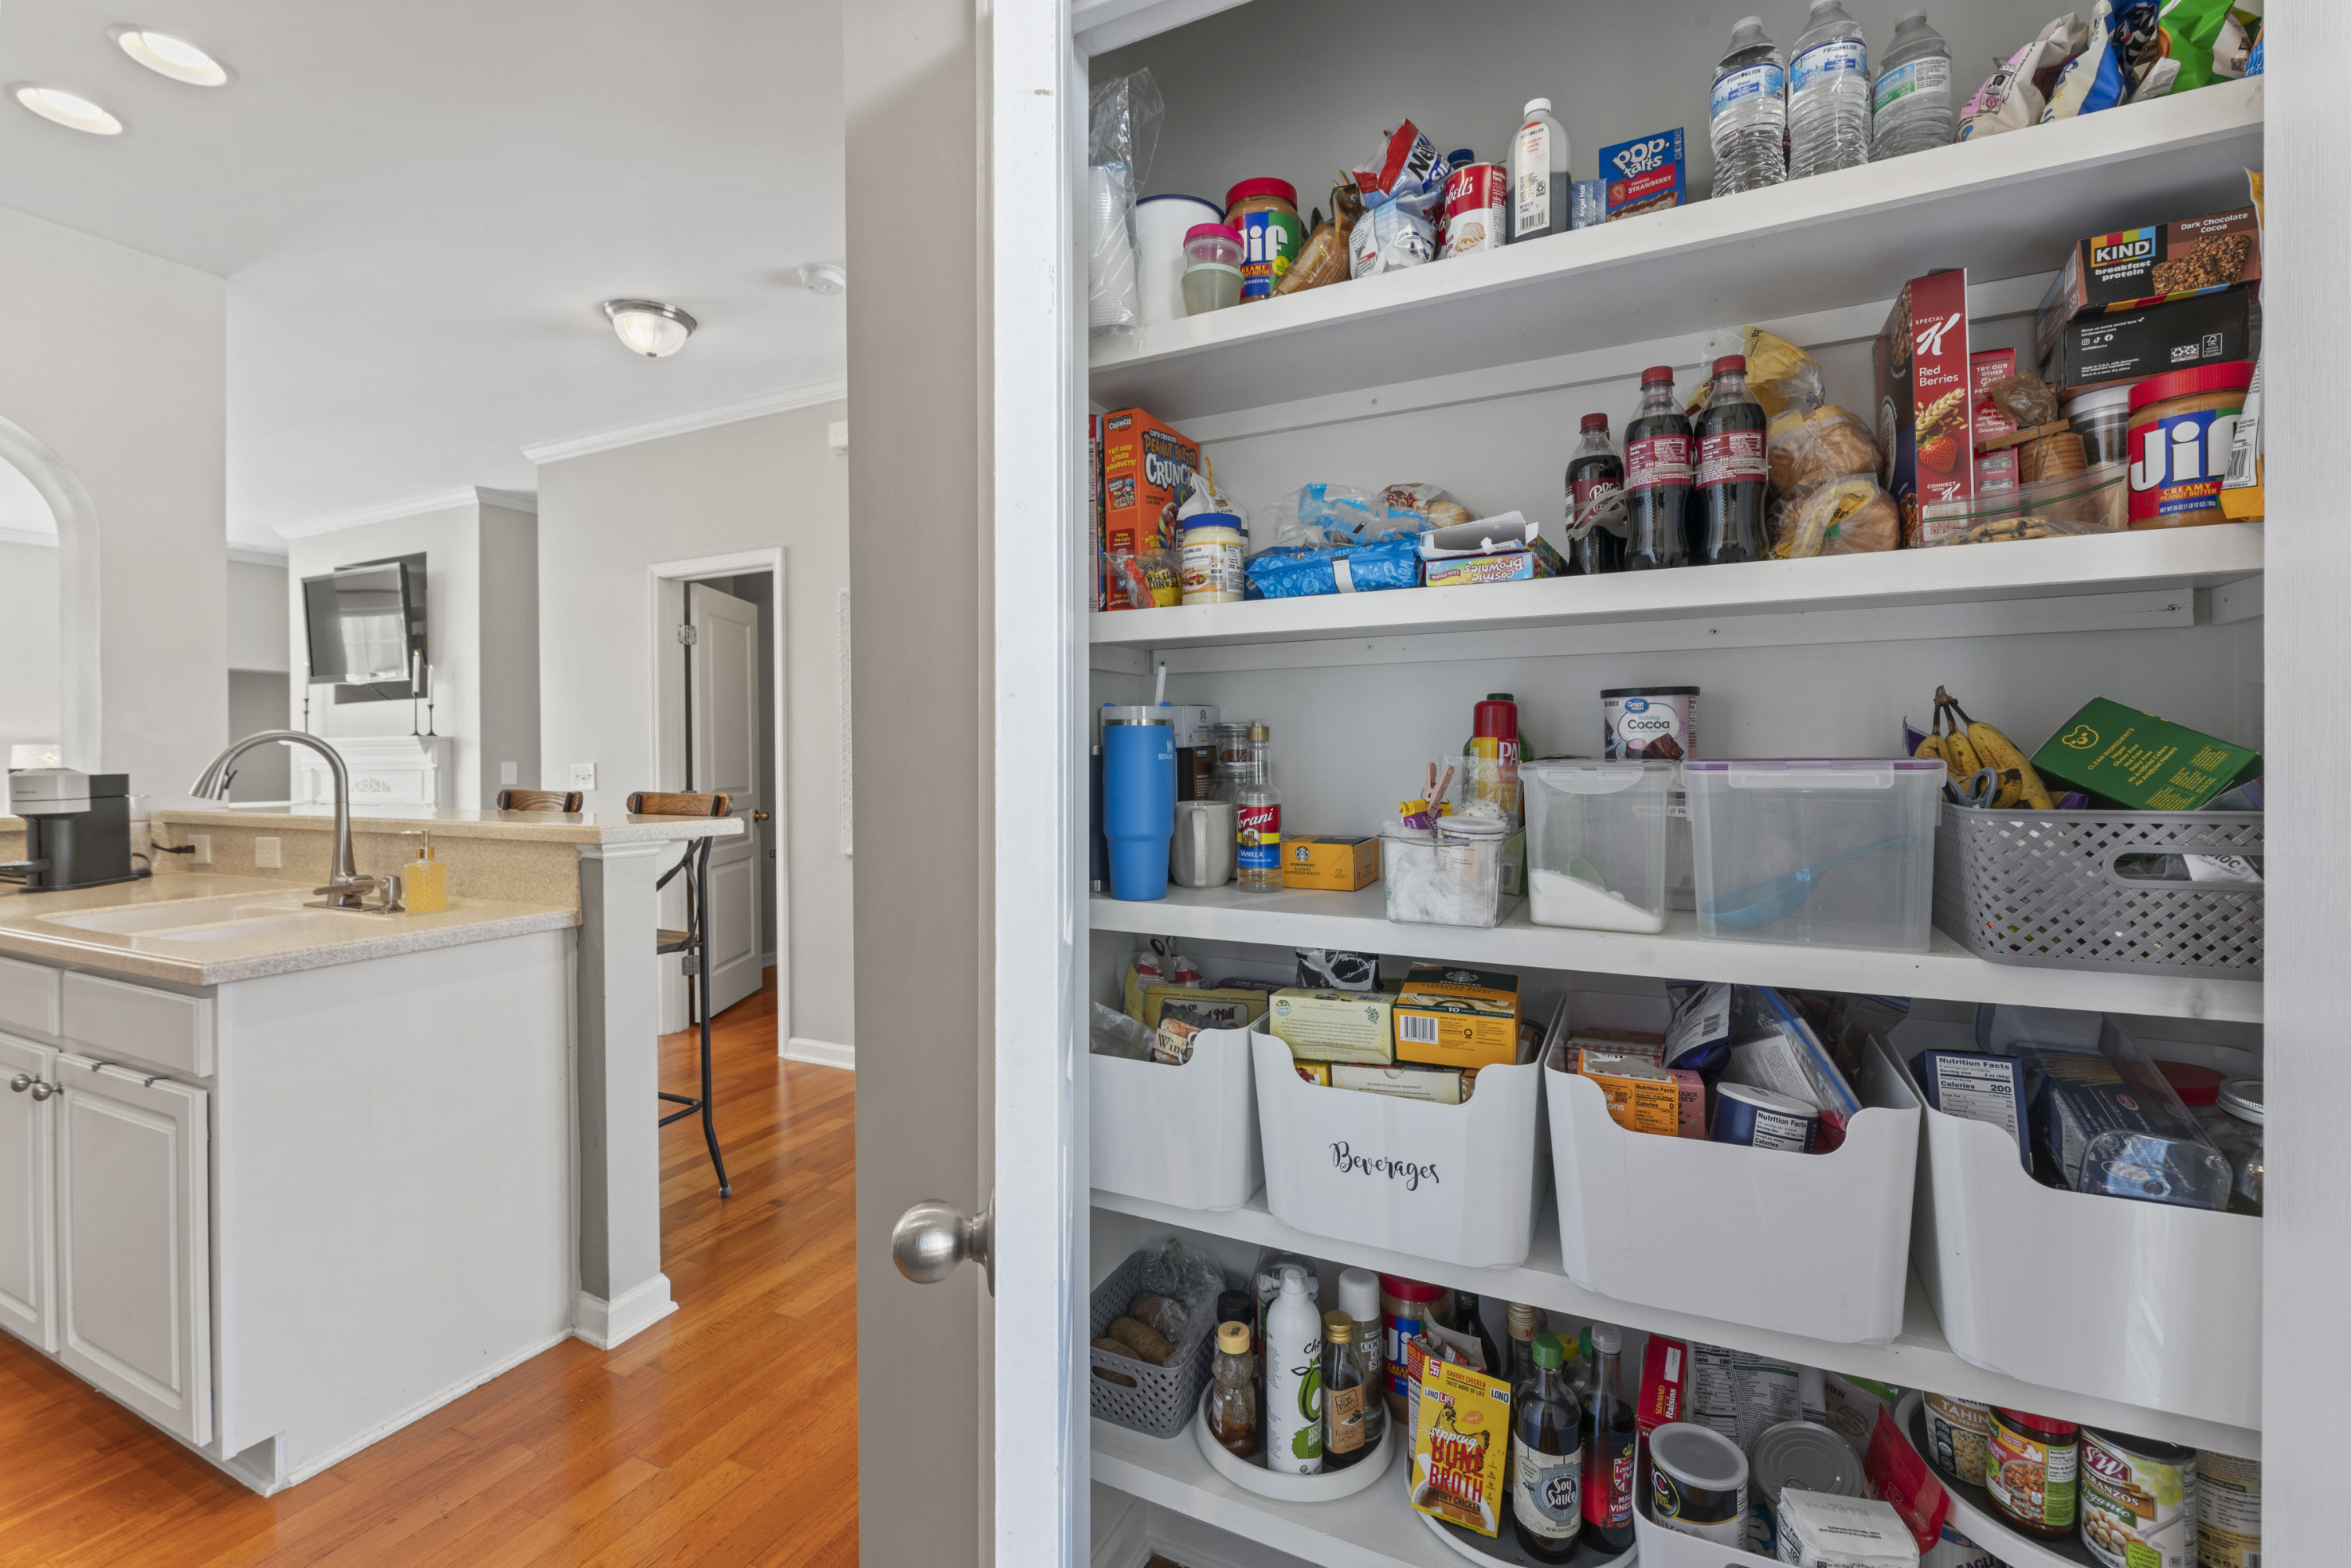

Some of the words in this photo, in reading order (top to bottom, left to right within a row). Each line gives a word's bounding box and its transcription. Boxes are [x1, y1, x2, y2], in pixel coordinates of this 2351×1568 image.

[1727, 74, 1741, 84] FOOD
[1628, 176, 1672, 194] STRAWBERRY
[1632, 177, 1650, 186] FROSTED
[2181, 221, 2201, 230] Dark
[2204, 212, 2248, 226] Chocolate
[2201, 223, 2227, 234] Cocoa
[2096, 241, 2150, 263] KIND
[2095, 260, 2151, 275] breakfast
[2102, 268, 2144, 281] protein
[1915, 315, 1944, 325] SPECIAL
[1916, 313, 1962, 356] K
[1919, 365, 1940, 376] Red
[1920, 373, 1958, 386] Berries
[1109, 418, 1132, 429] CRUNCH
[1144, 433, 1173, 459] PEANUT
[1175, 444, 1197, 466] BUTTER
[1630, 444, 1646, 452] Nutrition
[1111, 453, 1129, 462] OTHER
[1106, 459, 1136, 473] PRODUCTS!
[1927, 480, 1956, 489] CONNECT
[2164, 483, 2211, 495] CREAMY
[2161, 491, 2189, 502] PEANUT
[2190, 488, 2217, 497] BUTTER
[1464, 556, 1523, 573] Brownies
[1471, 569, 1515, 583] Cosmic
[1628, 719, 1670, 730] Cocoa
[2087, 755, 2106, 770] CLEAN
[2104, 727, 2135, 757] INGREDIENTS
[2110, 745, 2127, 759] Vegan
[2113, 752, 2130, 767] Gluten
[2127, 744, 2140, 755] Free
[2123, 758, 2135, 768] Nut
[2132, 749, 2144, 760] Free
[2129, 759, 2143, 772] Dairy
[2140, 750, 2154, 762] Free
[2134, 757, 2156, 777] Artificial
[2154, 745, 2169, 760] Colors
[2135, 778, 2144, 787] No
[2142, 760, 2164, 781] Artificial
[2161, 746, 2179, 764] Flavors
[1237, 808, 1274, 829] Torani
[1940, 1057, 1980, 1066] Nutrition
[1983, 1061, 2010, 1070] Facts
[1941, 1081, 1976, 1089] Calories
[1991, 1085, 2012, 1093] 200
[1758, 1112, 1789, 1125] Nutrition
[1791, 1120, 1806, 1128] Facts
[1755, 1137, 1779, 1148] Calories
[1329, 1141, 1439, 1191] Beverages
[1383, 1327, 1412, 1365] Ji
[1430, 1358, 1441, 1378] LIFE
[1446, 1369, 1465, 1382] SAVORY
[1465, 1375, 1487, 1389] CHICKEN
[1446, 1379, 1457, 1389] TASTE
[1458, 1383, 1469, 1392] MORE
[1425, 1388, 1439, 1400] LONO
[1440, 1394, 1454, 1405] LIFE
[1491, 1389, 1509, 1403] LONO
[1665, 1388, 1677, 1419] Raisins
[1930, 1402, 1957, 1420] GROUND
[1958, 1418, 1987, 1431] SESAME
[1430, 1426, 1478, 1452] sipping
[1431, 1435, 1487, 1479] BONE
[2082, 1445, 2125, 1476] S&W
[1429, 1463, 1483, 1503] BROTH
[1553, 1477, 1572, 1496] Soy
[1429, 1487, 1452, 1501] SAVORY
[1454, 1497, 1481, 1513] CHICKEN
[1548, 1490, 1576, 1505] Sauce
